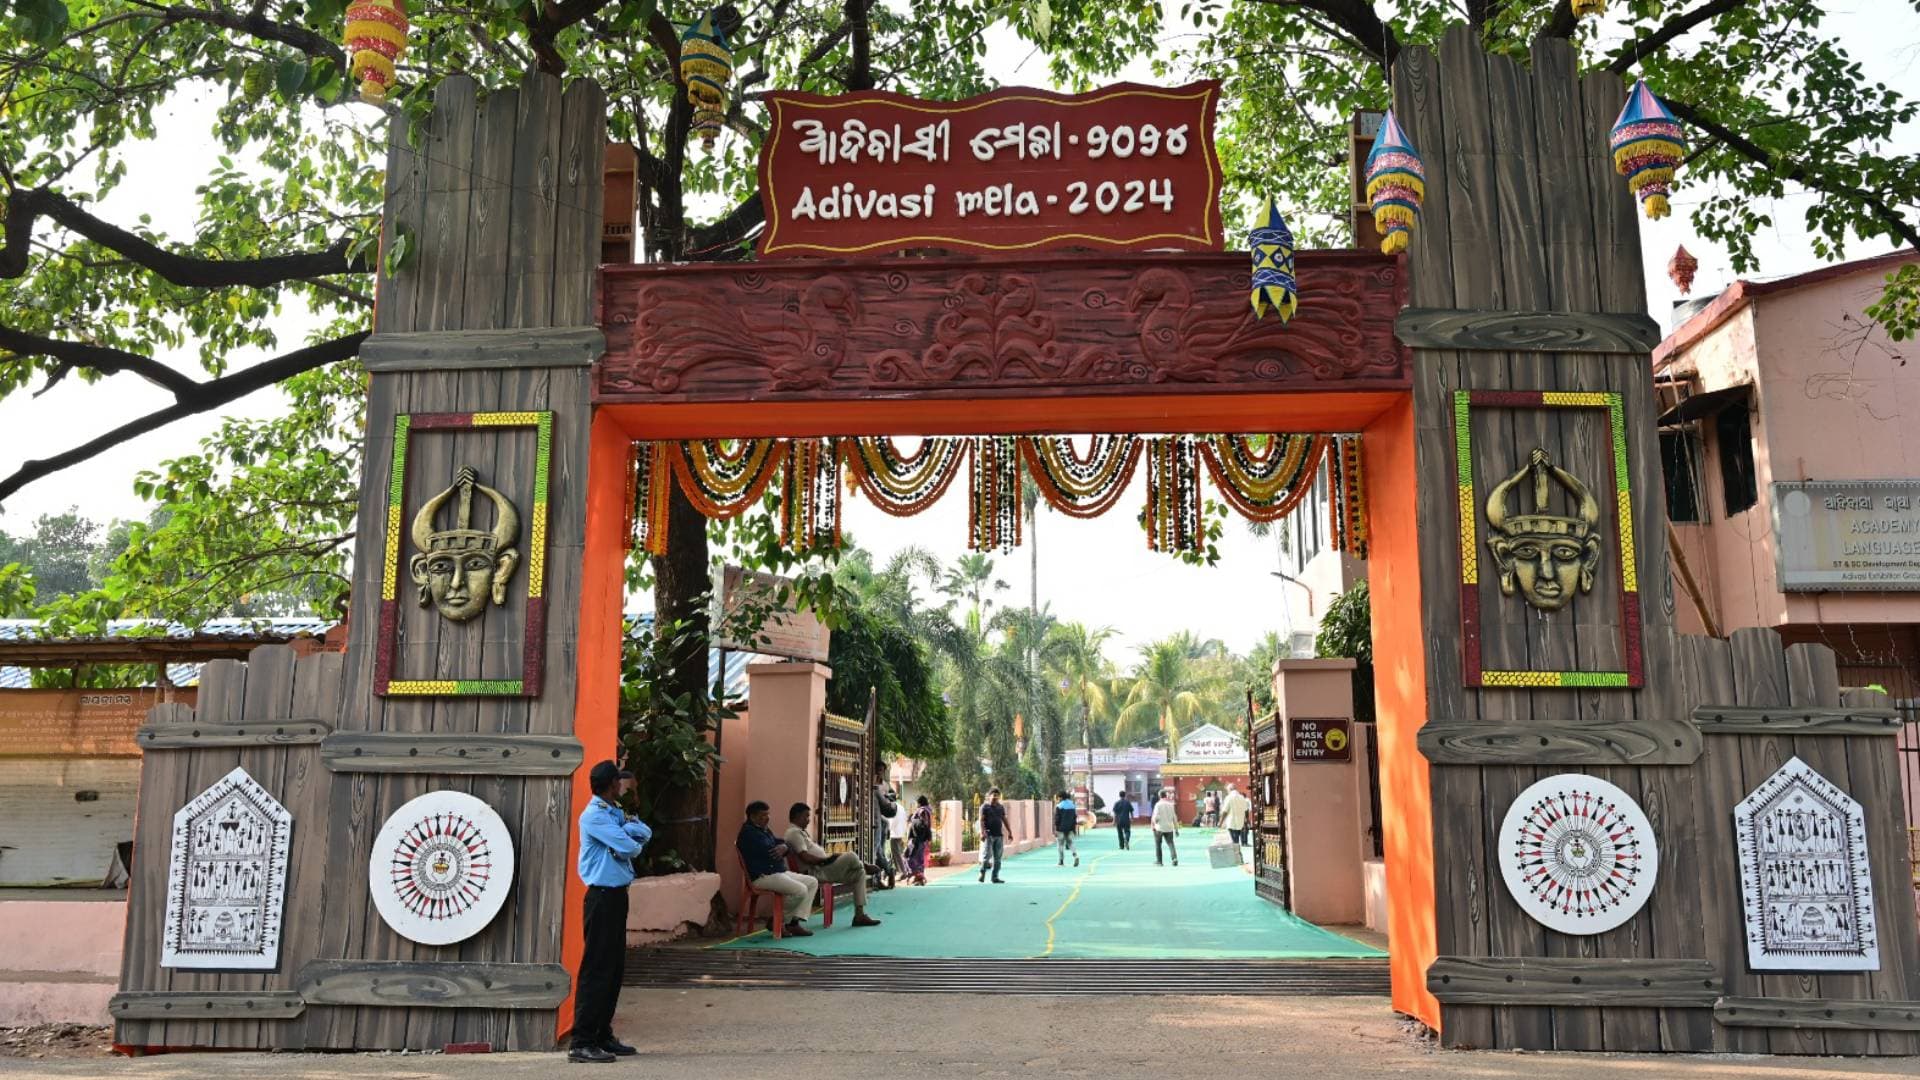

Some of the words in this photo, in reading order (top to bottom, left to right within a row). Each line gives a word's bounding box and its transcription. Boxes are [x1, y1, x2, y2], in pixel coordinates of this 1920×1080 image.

[792, 118, 951, 164] ଆଦିବାସୀ
[791, 182, 936, 220] Adivasi
[1851, 519, 1920, 534] ACADEMY
[1842, 541, 1920, 555] LANGUAGE
[1862, 560, 1907, 569] Development
[1302, 722, 1317, 731] NO
[1295, 731, 1324, 740] MASK
[1302, 740, 1318, 749] NO
